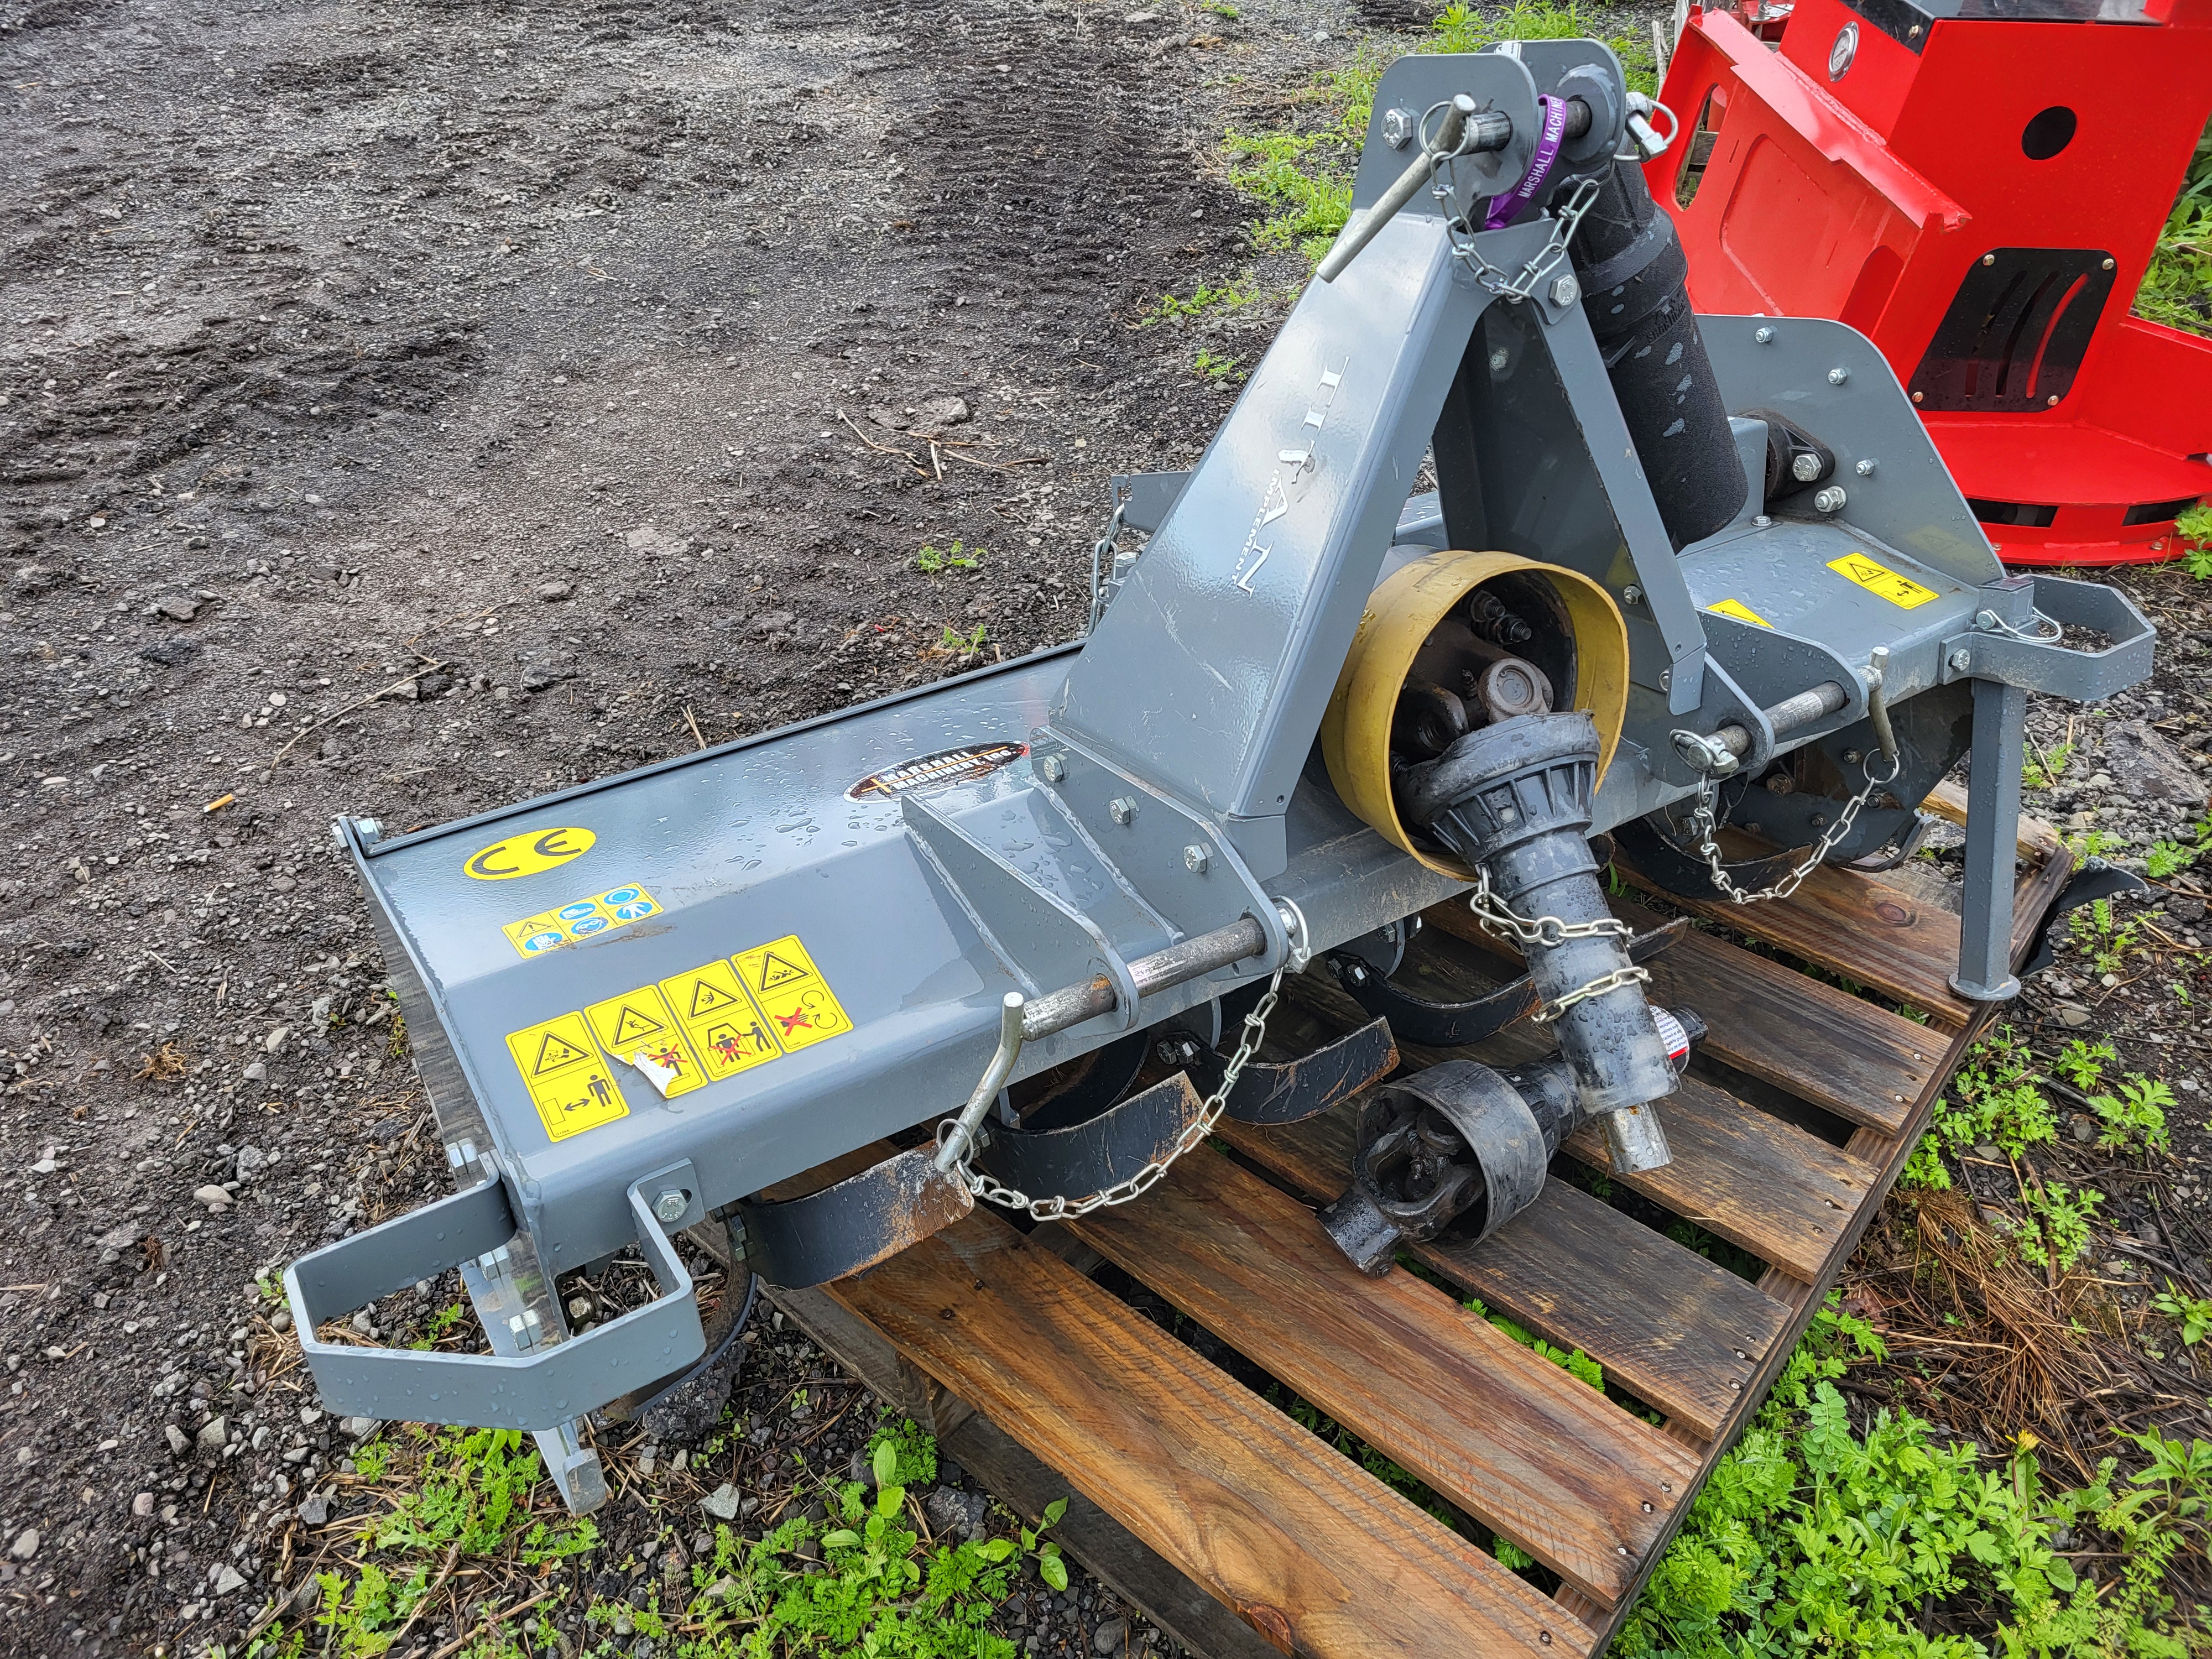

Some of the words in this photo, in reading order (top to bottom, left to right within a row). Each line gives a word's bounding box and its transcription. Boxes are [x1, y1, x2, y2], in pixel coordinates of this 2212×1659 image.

[1517, 149, 1553, 198] MARSHALL
[1231, 468, 1280, 585] IMPLEMENT
[881, 751, 974, 782] MARSHALL
[471, 829, 582, 875] CE
